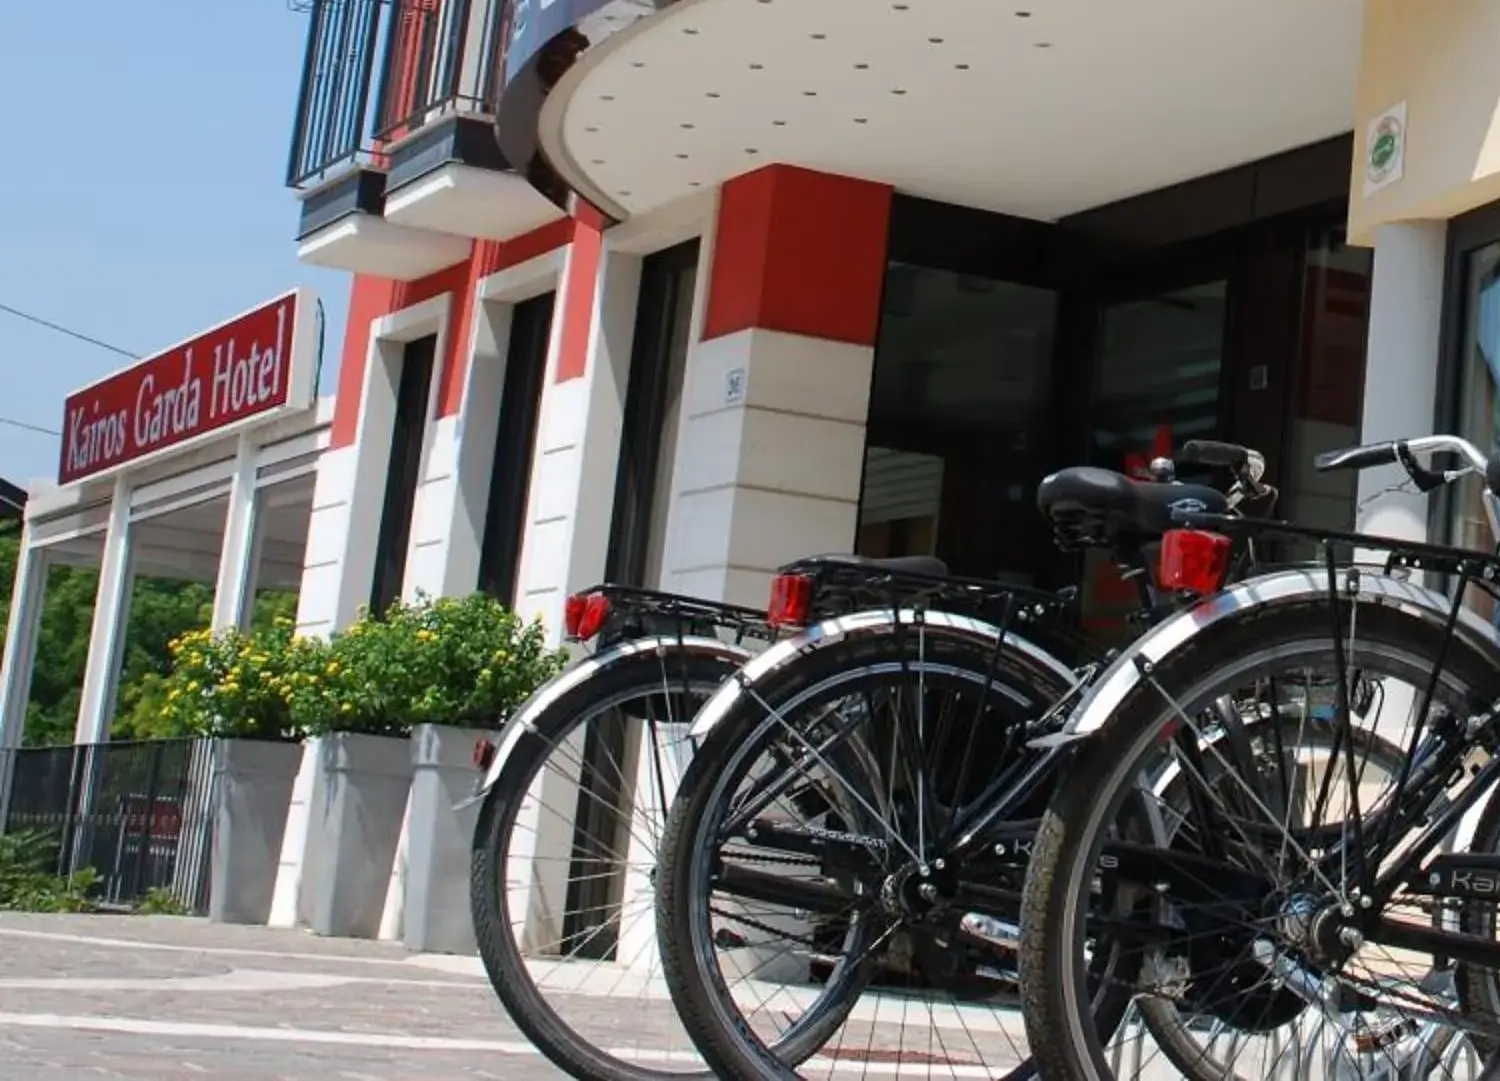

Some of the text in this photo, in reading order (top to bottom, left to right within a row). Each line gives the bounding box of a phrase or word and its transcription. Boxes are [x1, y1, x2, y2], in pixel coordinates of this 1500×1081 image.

[67, 304, 287, 472] Kairos Garda Hotel
